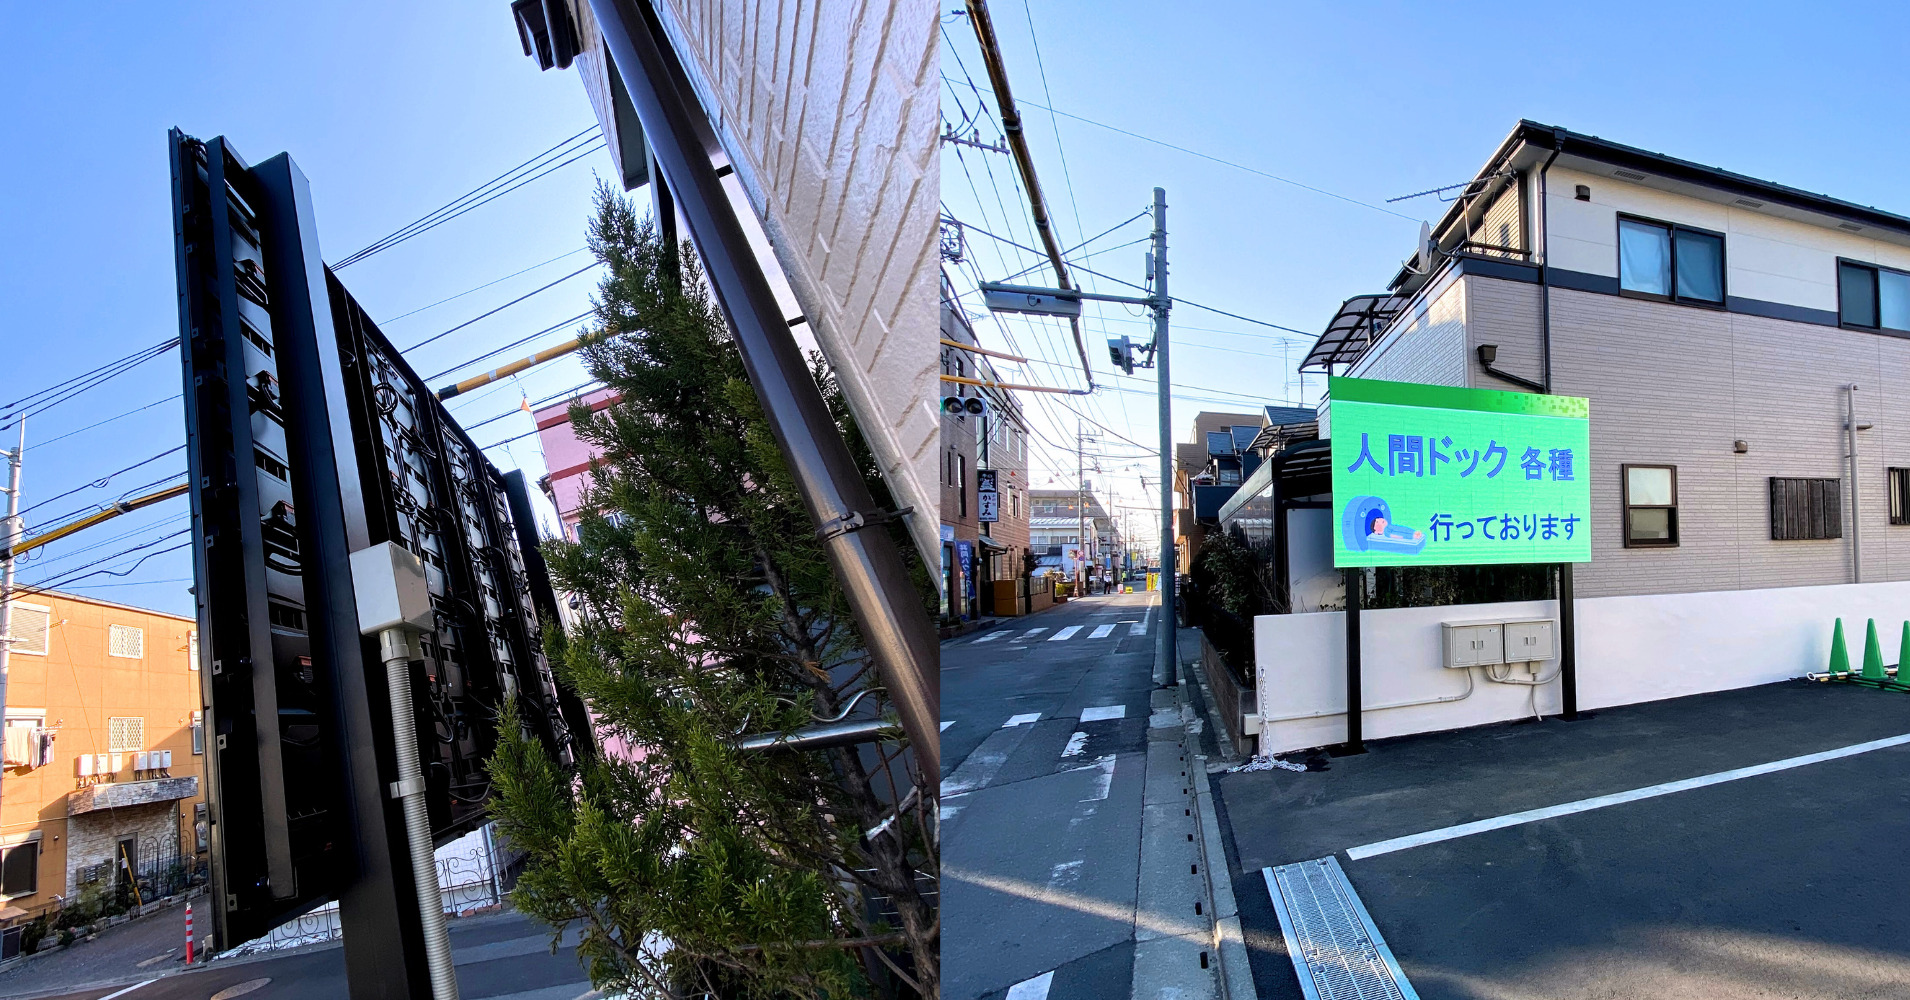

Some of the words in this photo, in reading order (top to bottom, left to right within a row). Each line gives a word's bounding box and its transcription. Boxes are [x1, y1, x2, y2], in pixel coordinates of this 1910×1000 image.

[1347, 432, 1508, 479] 人間ドック
[1520, 446, 1575, 481] 各種
[982, 494, 992, 516] かすみ
[1429, 513, 1581, 542] 行っております
